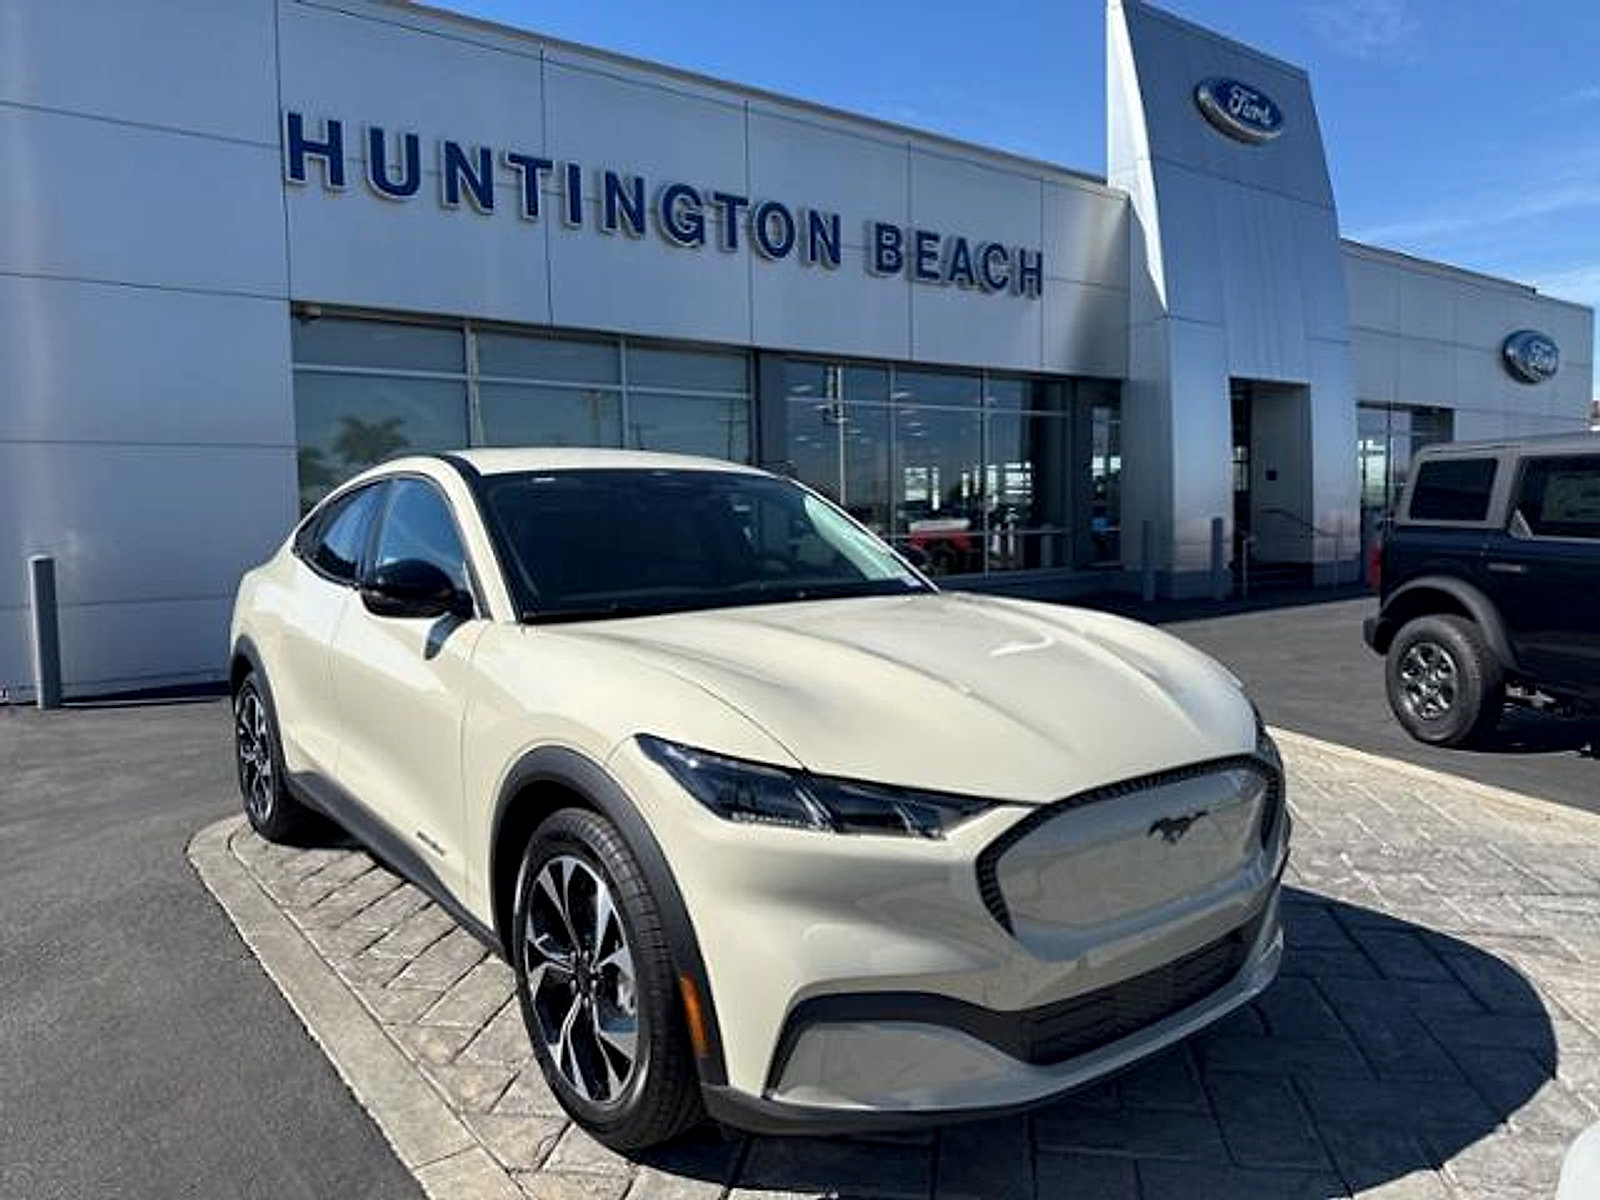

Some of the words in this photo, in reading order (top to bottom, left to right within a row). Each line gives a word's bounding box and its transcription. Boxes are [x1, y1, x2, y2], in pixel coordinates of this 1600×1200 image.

[1228, 85, 1272, 124] Ford
[285, 111, 842, 266] HUNTINGTON
[872, 221, 1042, 297] BEACH
